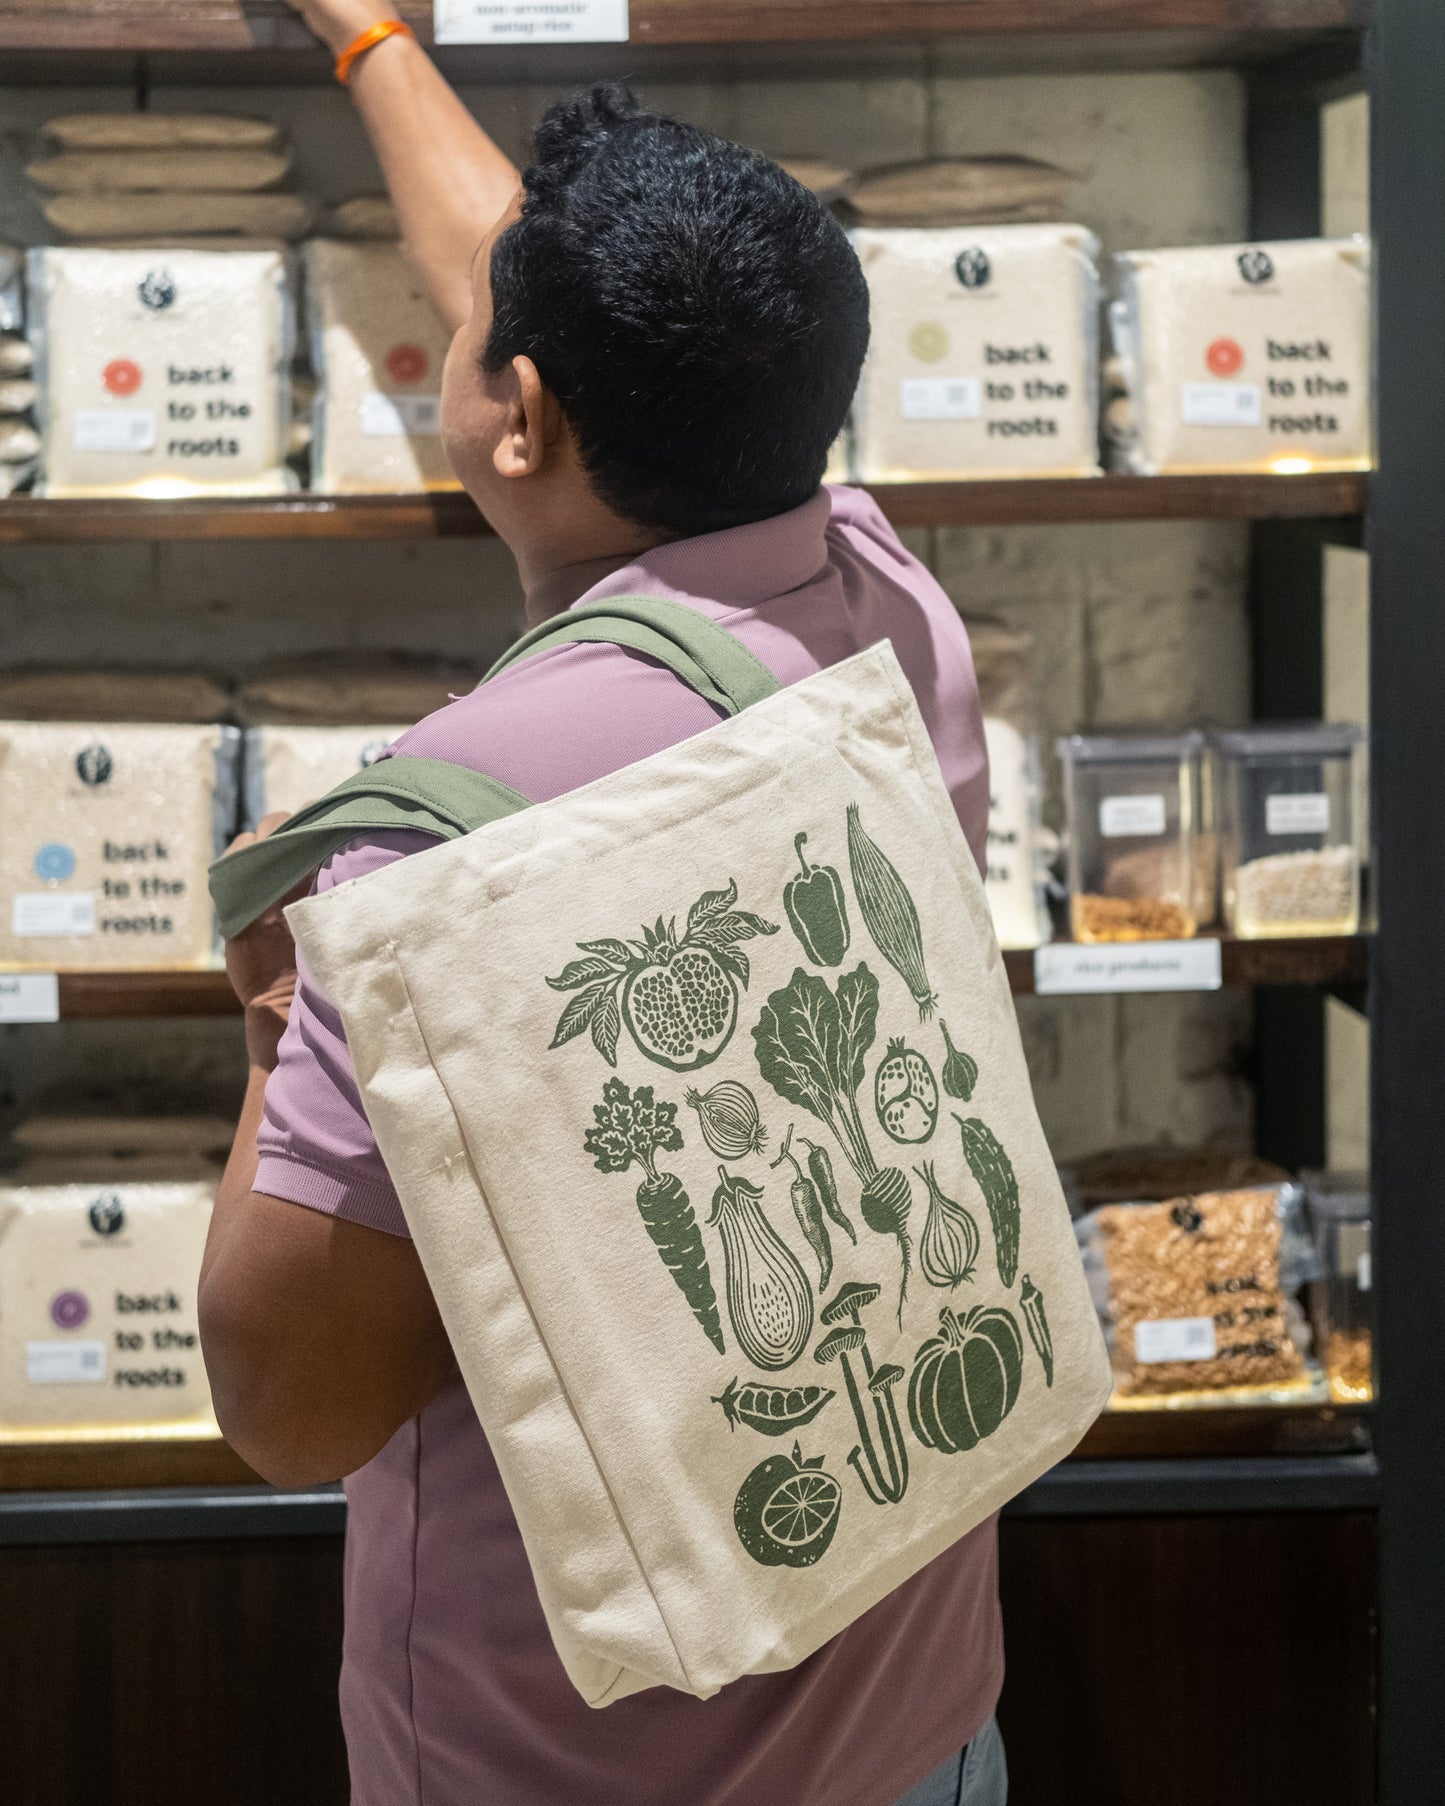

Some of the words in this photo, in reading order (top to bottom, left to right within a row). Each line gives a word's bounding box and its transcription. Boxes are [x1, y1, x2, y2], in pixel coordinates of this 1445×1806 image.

[985, 342, 1051, 365] back
[1267, 338, 1331, 361] back
[167, 364, 234, 386] back
[1268, 375, 1295, 397] to
[1304, 373, 1348, 396] the
[985, 378, 1014, 401] to
[1023, 375, 1069, 400] the
[167, 400, 196, 421] to
[207, 398, 251, 420] the
[987, 413, 1058, 438] roots
[1268, 411, 1339, 435] roots
[167, 434, 239, 458] roots
[103, 840, 168, 864] back
[103, 877, 130, 899] to
[140, 874, 185, 898] the
[102, 911, 173, 934] roots
[115, 1290, 181, 1314] back
[115, 1329, 144, 1350] to
[153, 1328, 196, 1348] the
[115, 1367, 186, 1387] roots
